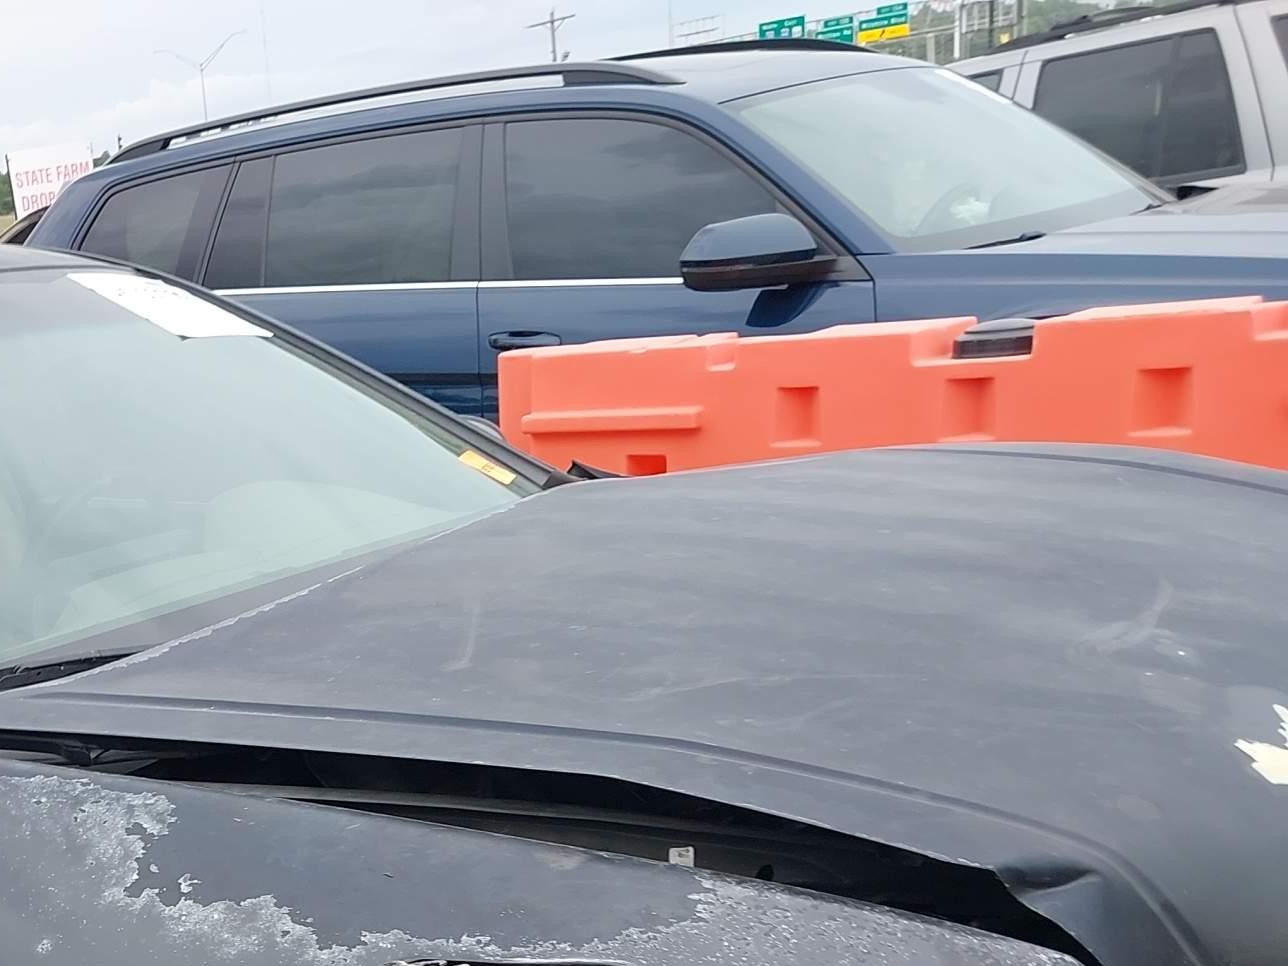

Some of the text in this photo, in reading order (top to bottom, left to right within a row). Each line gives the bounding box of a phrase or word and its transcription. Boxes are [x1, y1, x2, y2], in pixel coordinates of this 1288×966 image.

[15, 161, 90, 189] STATE FARM
[22, 191, 56, 212] DROP
